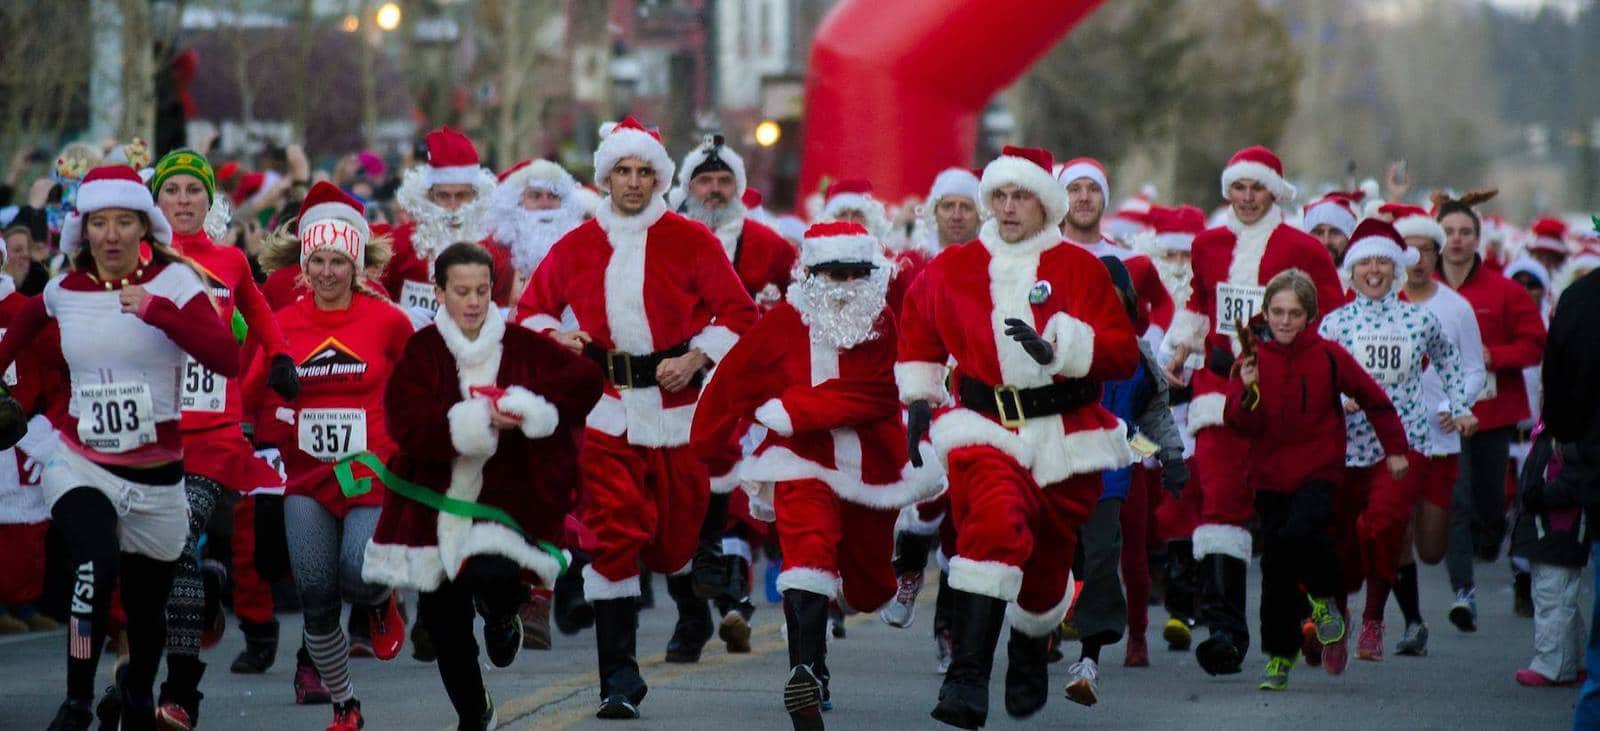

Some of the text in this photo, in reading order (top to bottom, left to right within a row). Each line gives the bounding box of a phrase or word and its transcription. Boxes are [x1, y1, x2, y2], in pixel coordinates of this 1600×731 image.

[331, 363, 368, 376] Runner
[1366, 344, 1401, 369] 398
[105, 388, 118, 397] THE
[120, 385, 144, 395] SANTAS
[186, 361, 215, 394] 58
[92, 399, 140, 434] 303
[311, 424, 353, 453] 357
[71, 560, 95, 613] USA
